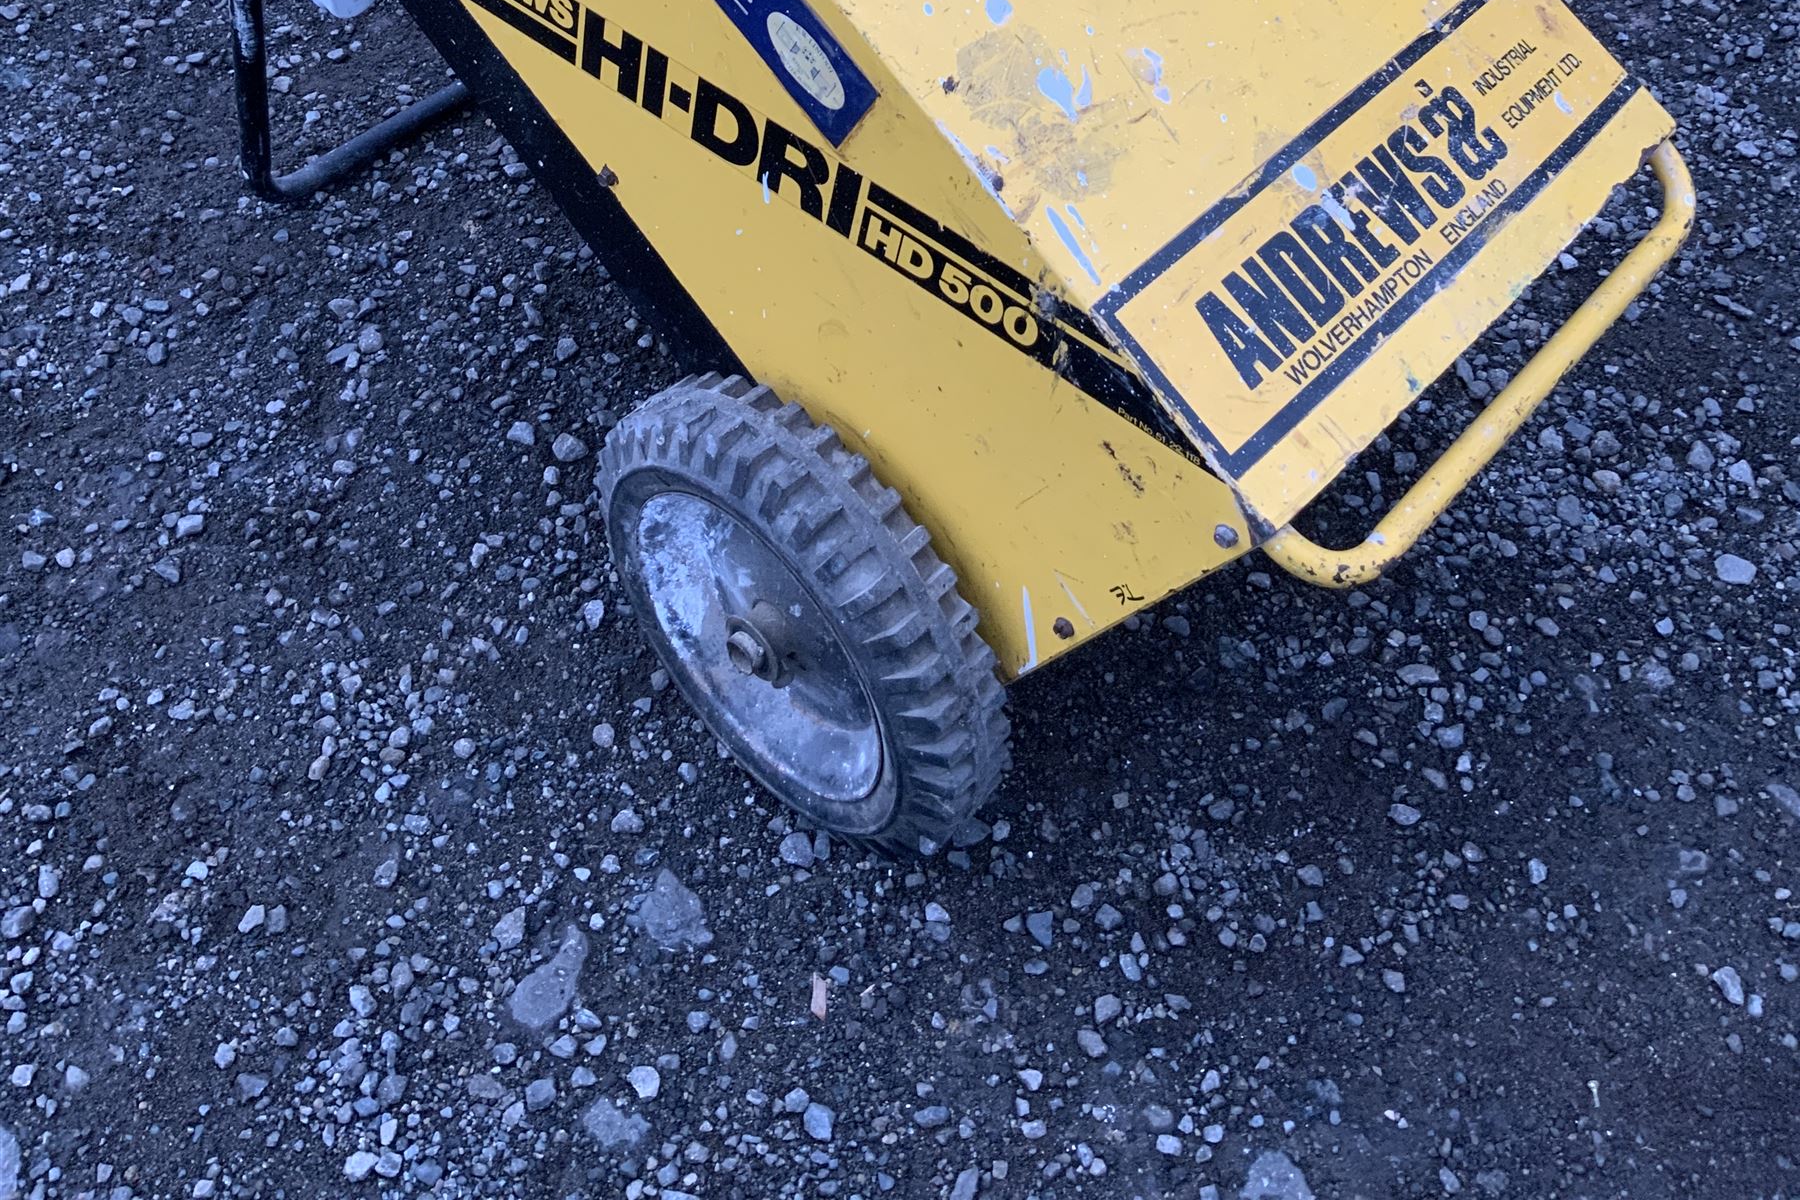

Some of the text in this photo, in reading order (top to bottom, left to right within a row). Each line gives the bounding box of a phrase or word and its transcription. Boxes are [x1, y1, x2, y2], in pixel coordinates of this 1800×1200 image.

[1472, 39, 1537, 96] INDUSTRIAL
[1501, 53, 1583, 129] EQUIPMENT LTD.
[582, 7, 864, 240] HI-DRI
[864, 215, 935, 280] HD
[938, 262, 1039, 347] 500
[1195, 124, 1466, 391] ANDREWS
[1283, 178, 1508, 387] WOLVERHAMPTON ENGLAND
[1117, 406, 1138, 425] Part
